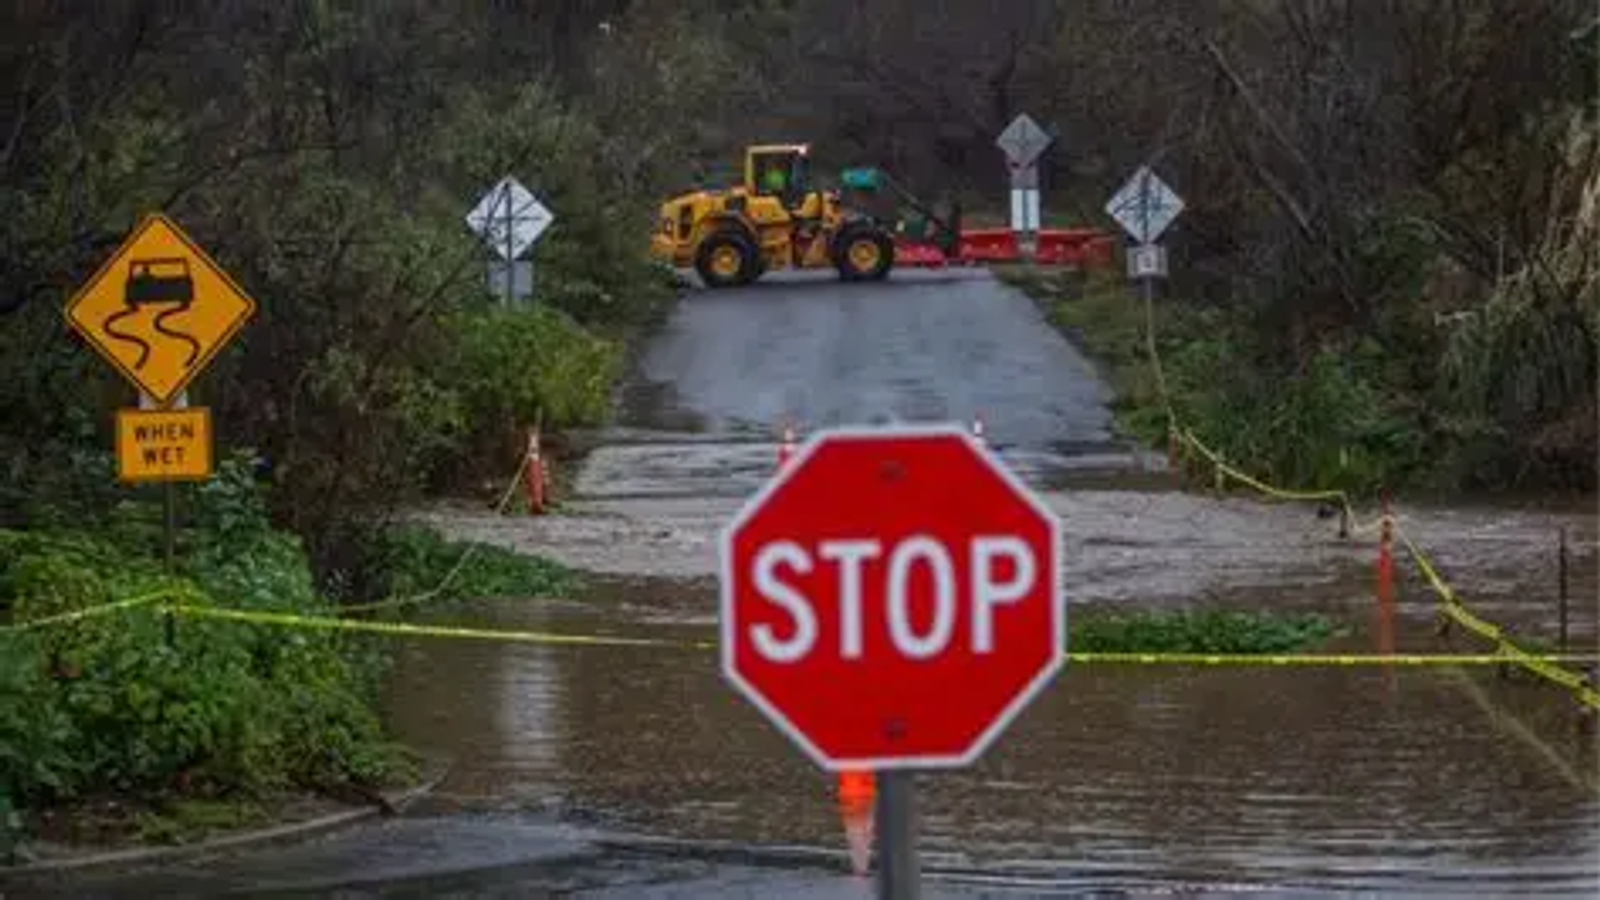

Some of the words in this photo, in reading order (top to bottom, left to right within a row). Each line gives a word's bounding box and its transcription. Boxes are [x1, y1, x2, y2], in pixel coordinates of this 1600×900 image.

[133, 423, 194, 442] WHEN
[142, 446, 188, 467] WET
[751, 535, 1037, 662] STOP
